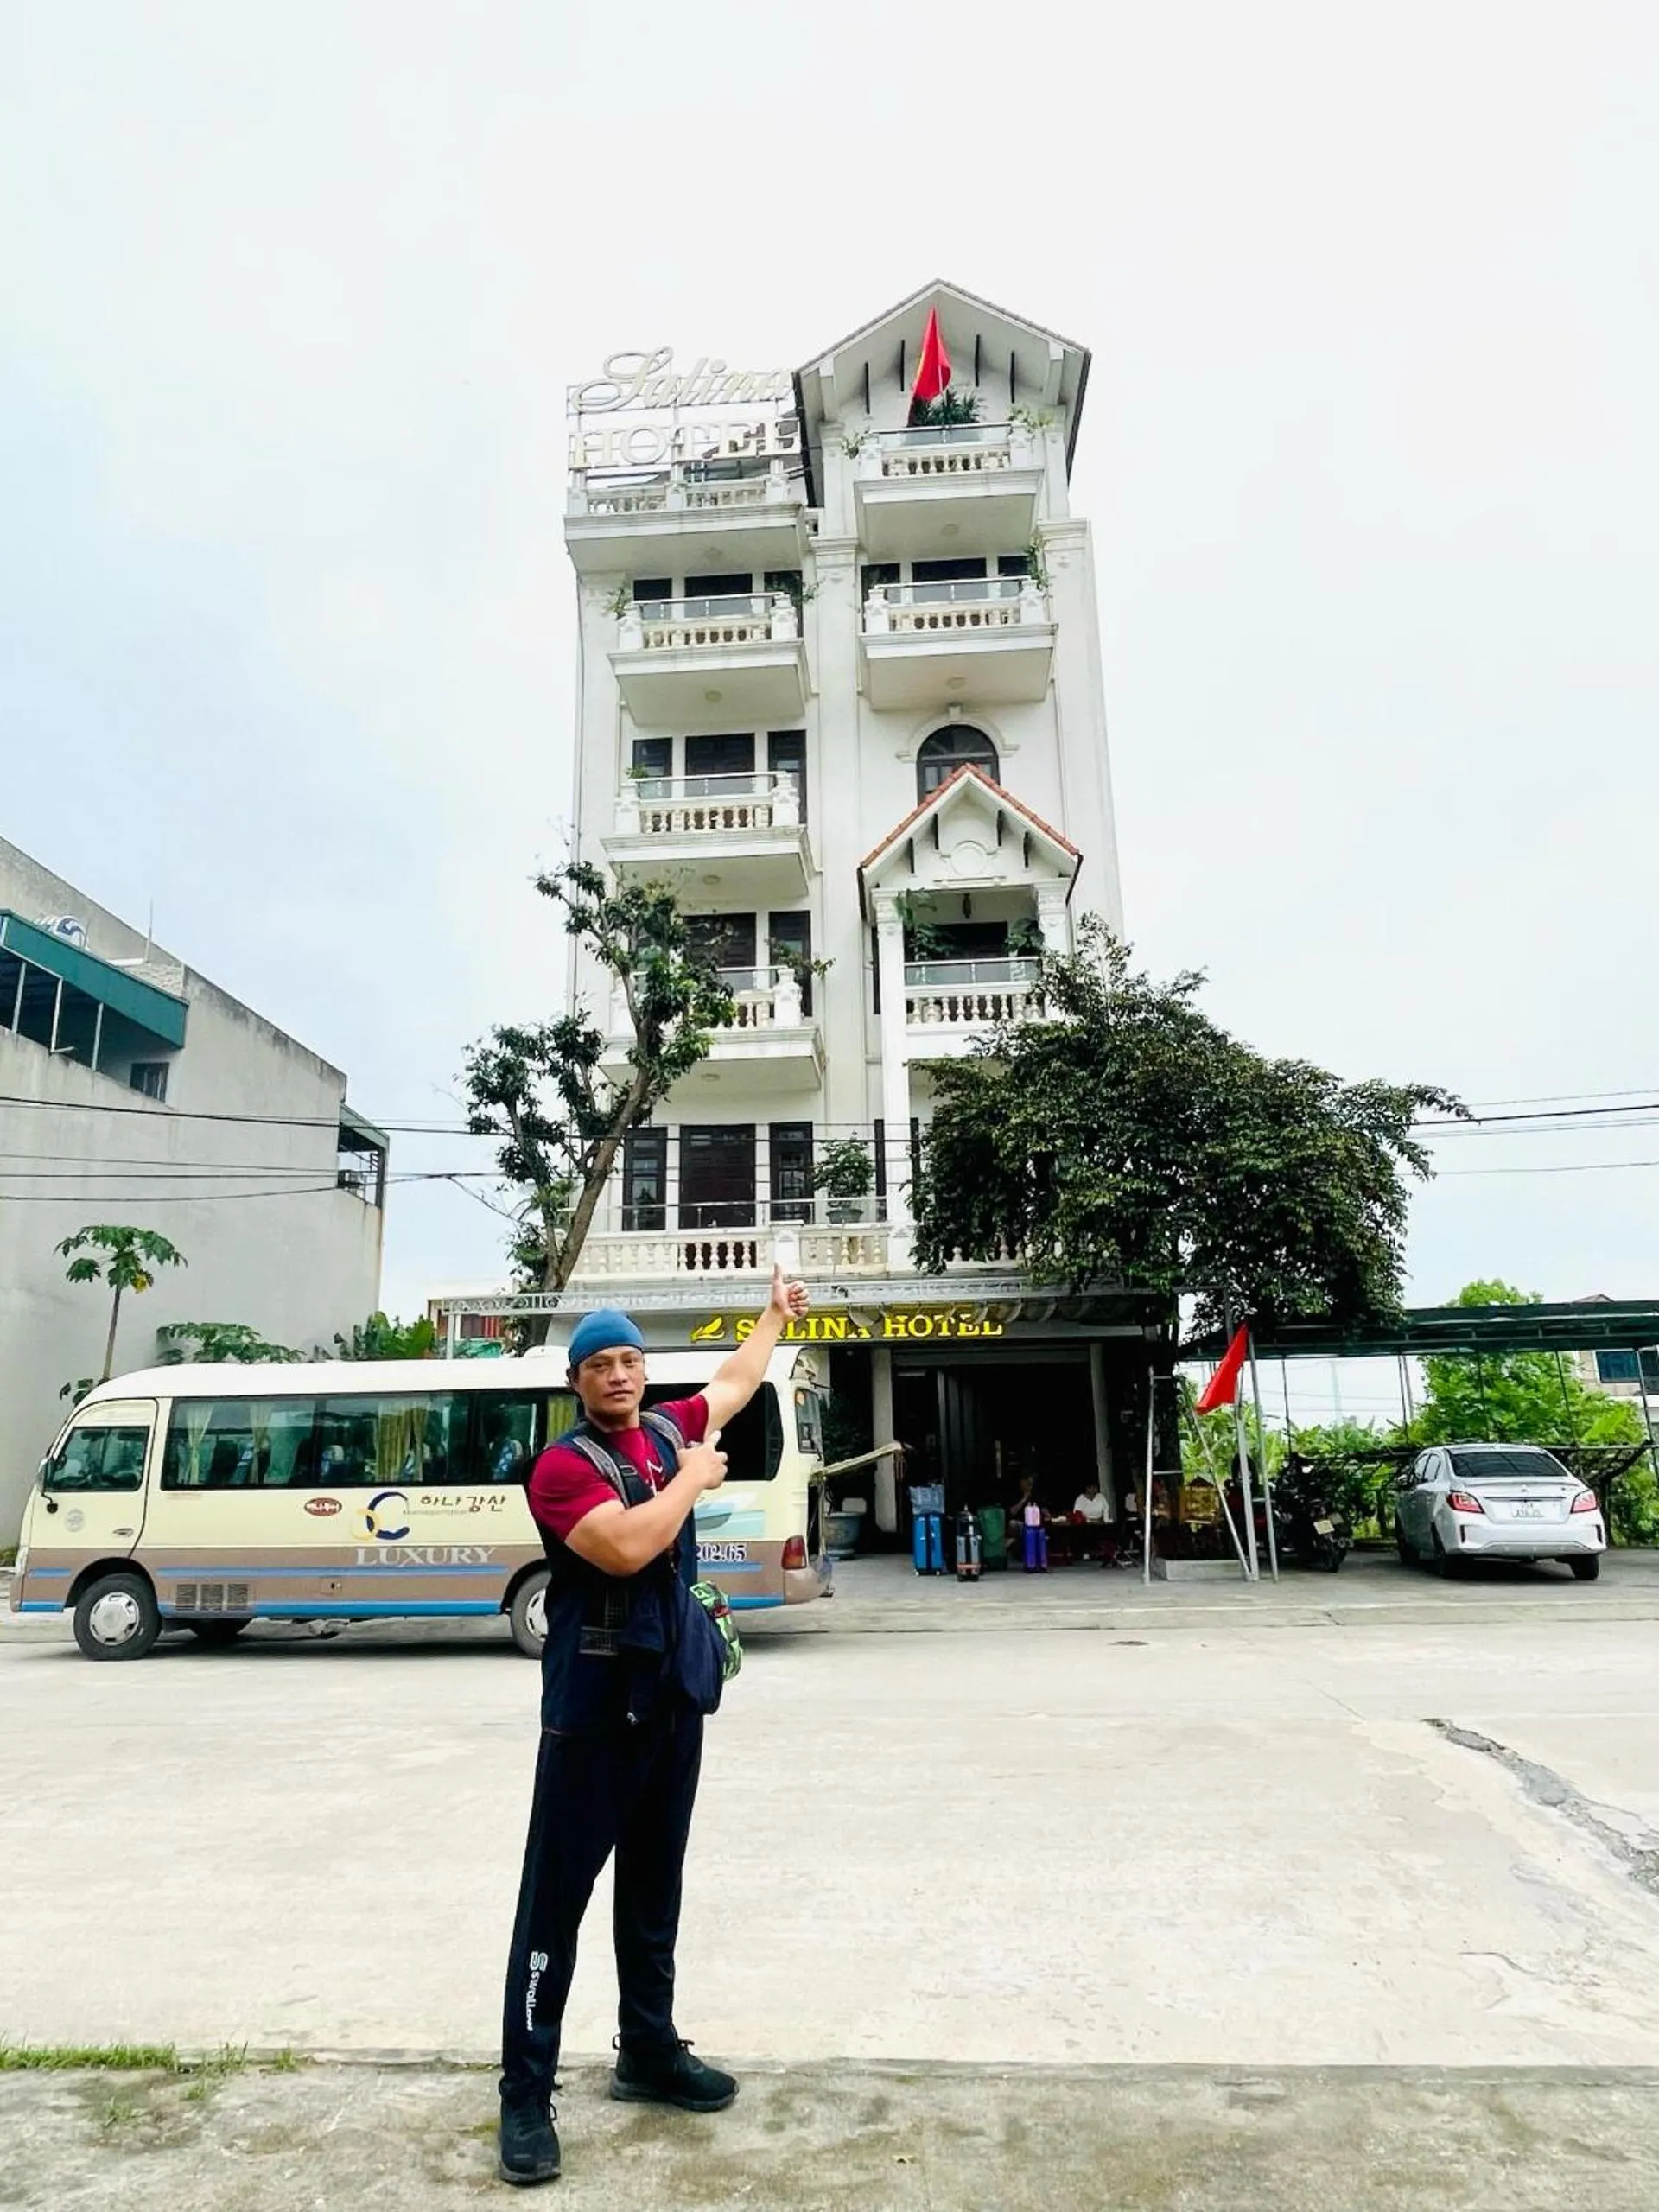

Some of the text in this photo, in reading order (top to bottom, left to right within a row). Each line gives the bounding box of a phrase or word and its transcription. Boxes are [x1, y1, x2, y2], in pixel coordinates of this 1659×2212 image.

[573, 346, 794, 412] Salina
[882, 1314, 1003, 1337] HOTEL
[356, 1547, 496, 1567] LUXURY
